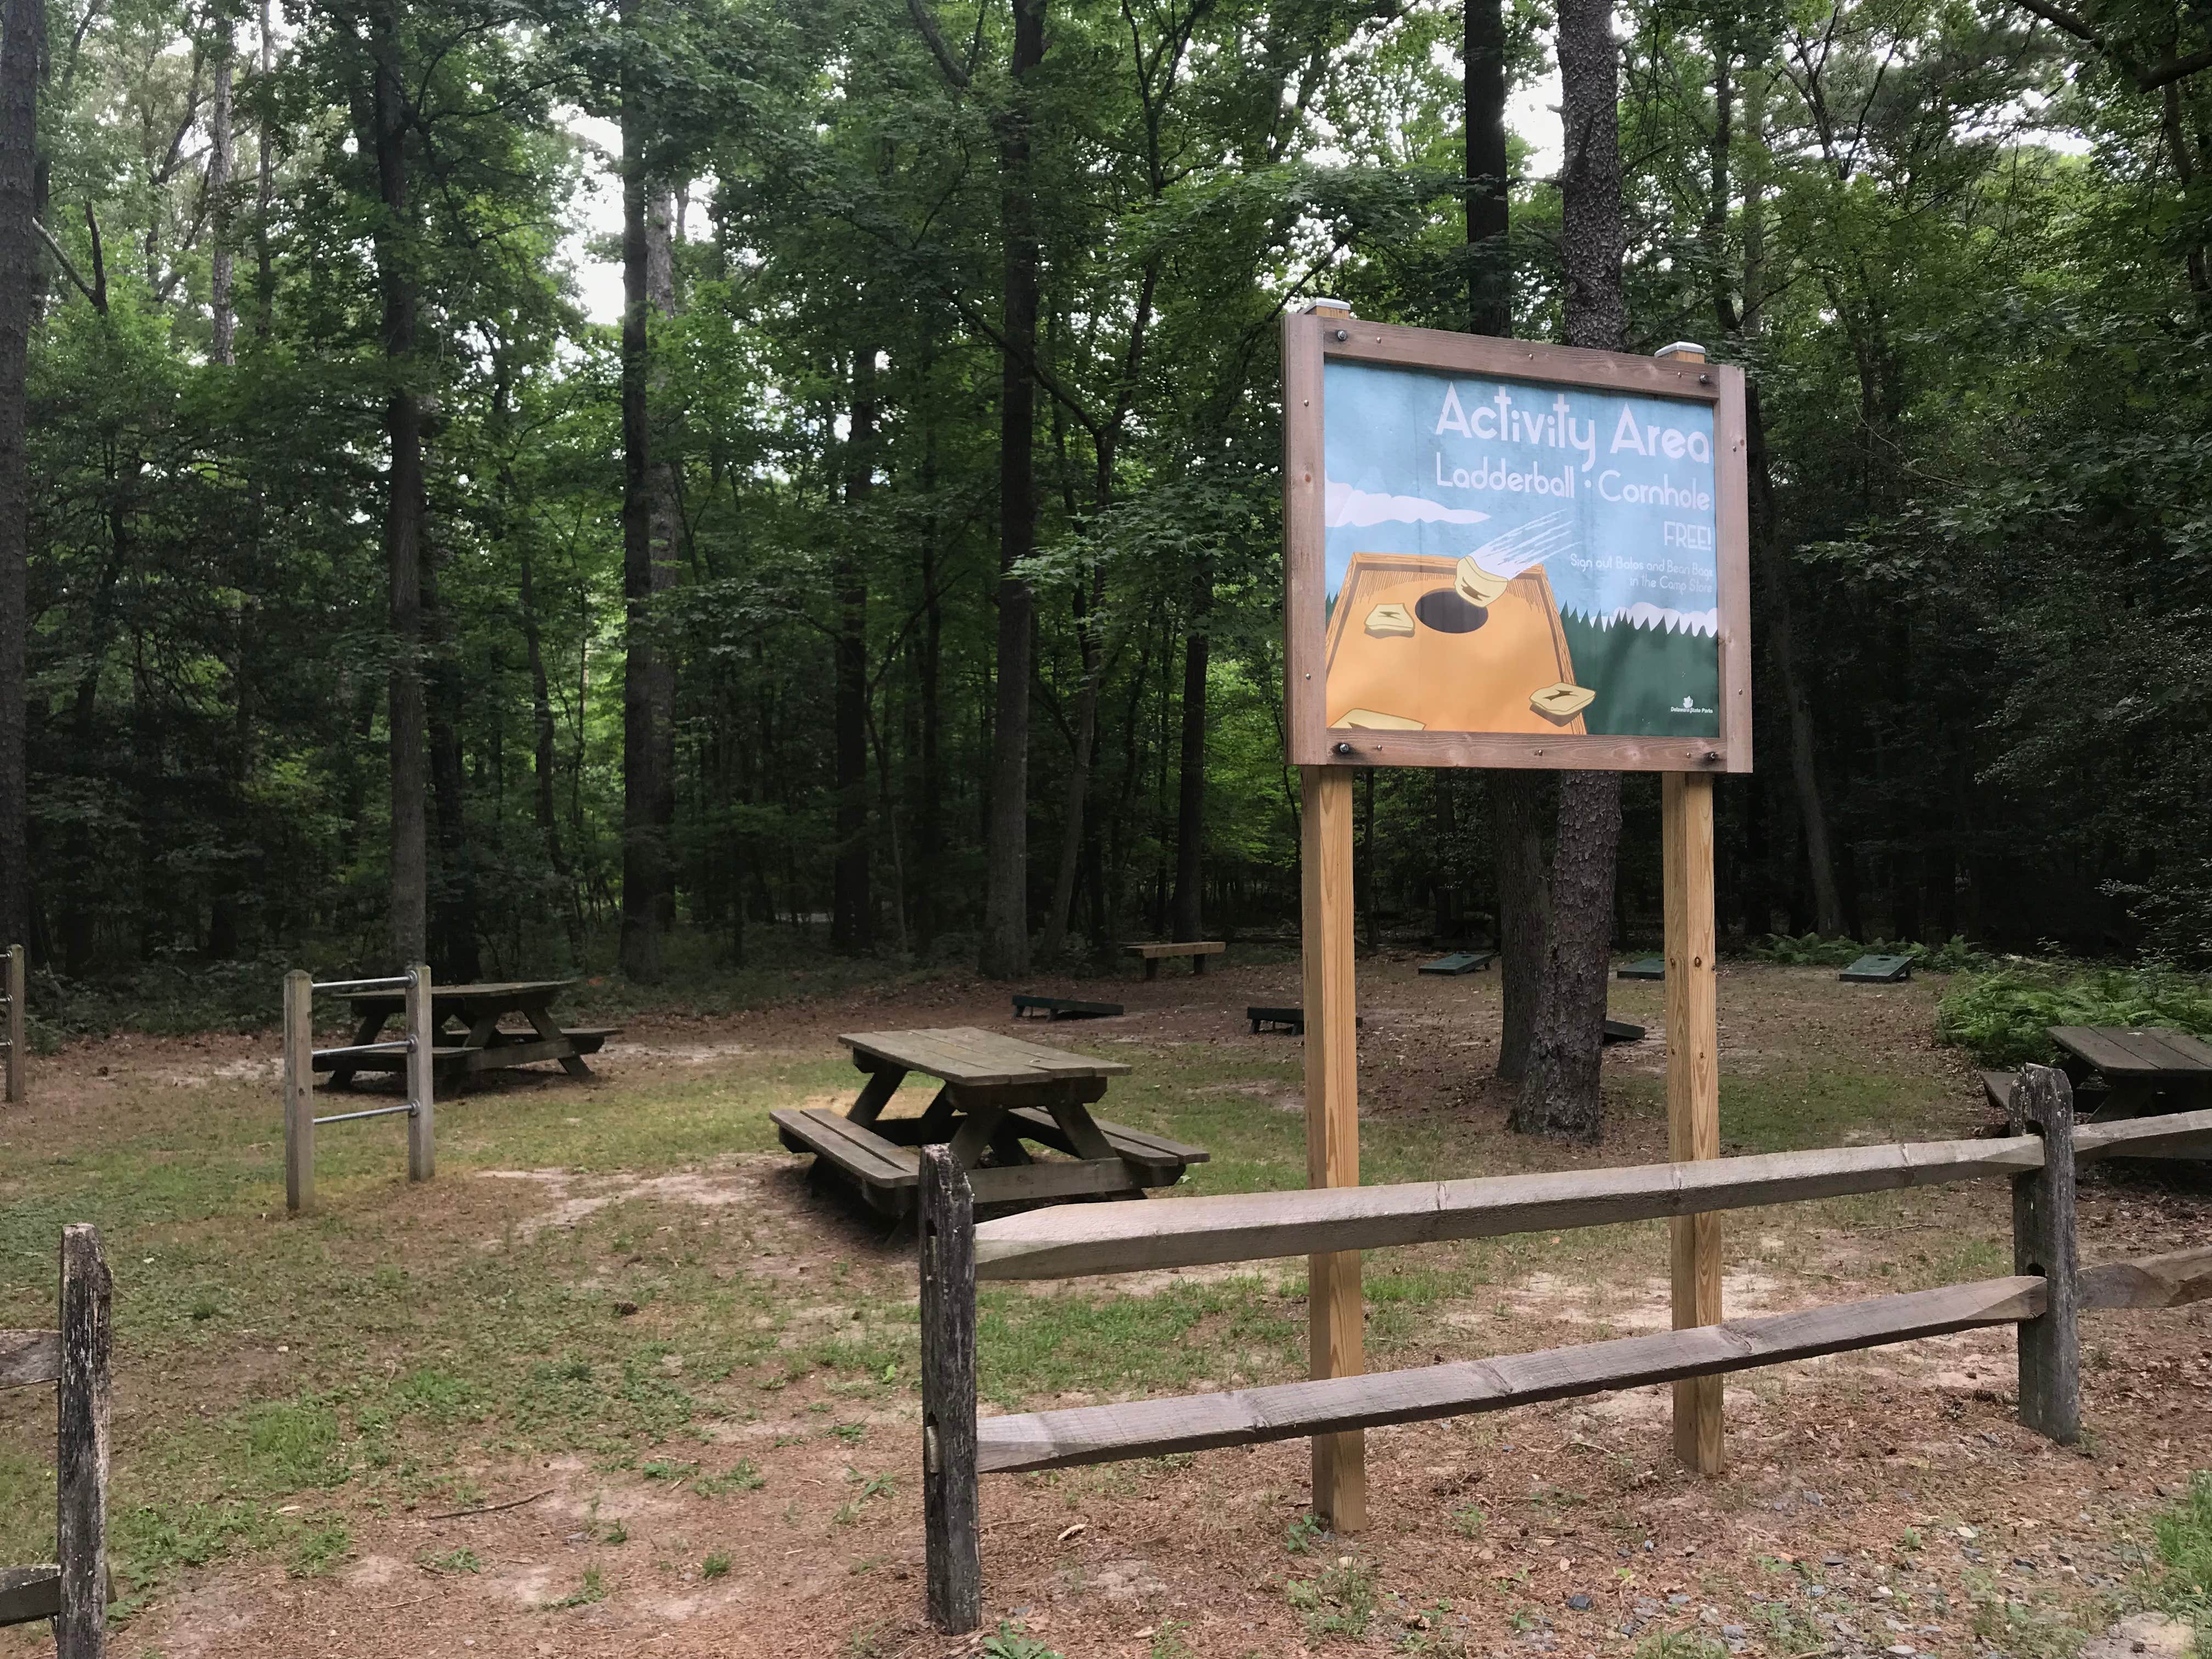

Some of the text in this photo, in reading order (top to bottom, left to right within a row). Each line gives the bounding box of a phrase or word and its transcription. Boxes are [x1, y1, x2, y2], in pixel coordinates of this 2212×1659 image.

[1435, 381, 1710, 472] Activity Area
[1436, 452, 1710, 510] Ladderball Cornhole
[1664, 521, 1712, 551] FREE!
[1570, 553, 1593, 572] Sign
[1595, 556, 1612, 569] out
[1646, 558, 1665, 572] and
[1667, 560, 1690, 575] Bean
[1691, 562, 1713, 580] Bags
[1630, 573, 1712, 595] in the Camp Store
